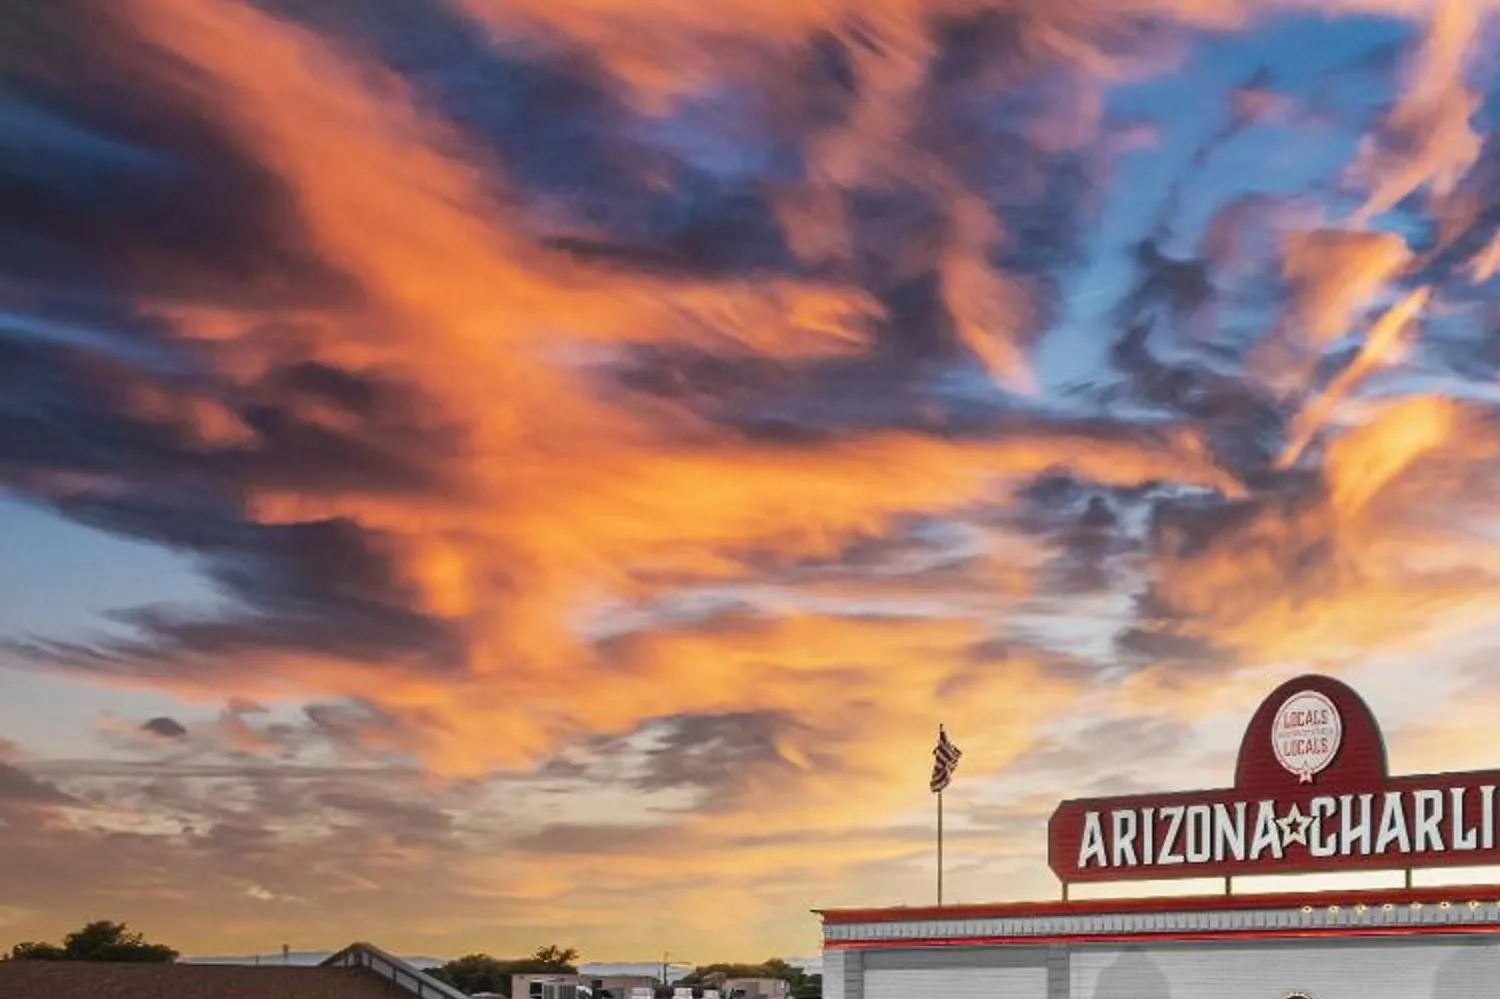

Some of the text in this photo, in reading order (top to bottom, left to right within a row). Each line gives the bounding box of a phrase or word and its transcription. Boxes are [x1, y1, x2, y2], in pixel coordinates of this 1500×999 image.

[1283, 709, 1329, 728] LOCALS
[1283, 737, 1329, 756] LOCALS
[1077, 799, 1283, 869] ARIZONA
